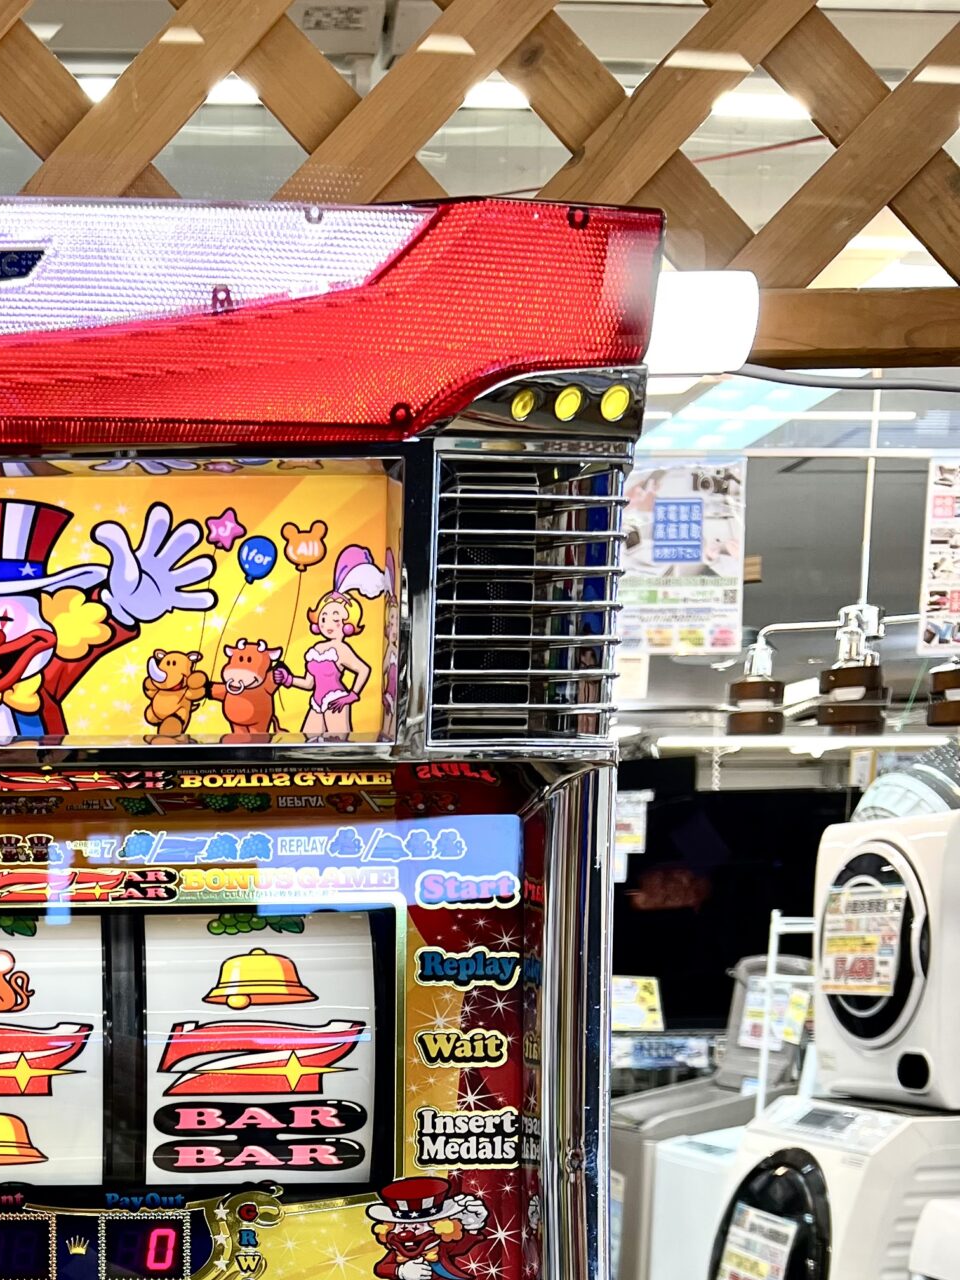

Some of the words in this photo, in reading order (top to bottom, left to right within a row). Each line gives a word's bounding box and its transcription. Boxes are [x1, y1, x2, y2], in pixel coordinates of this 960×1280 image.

[247, 548, 272, 566] for
[297, 541, 319, 557] All
[279, 837, 328, 855] REPLAY
[181, 868, 292, 890] BONUS
[293, 868, 398, 890] GAME
[422, 873, 517, 901] Start
[421, 951, 517, 983] Replay
[422, 1032, 504, 1060] Wait
[173, 1105, 343, 1132] BAR
[421, 1110, 517, 1134] Insert
[173, 1143, 341, 1170] BAR
[421, 1135, 517, 1161] Medals
[145, 1228, 176, 1270] 0
[236, 1253, 262, 1273] W
